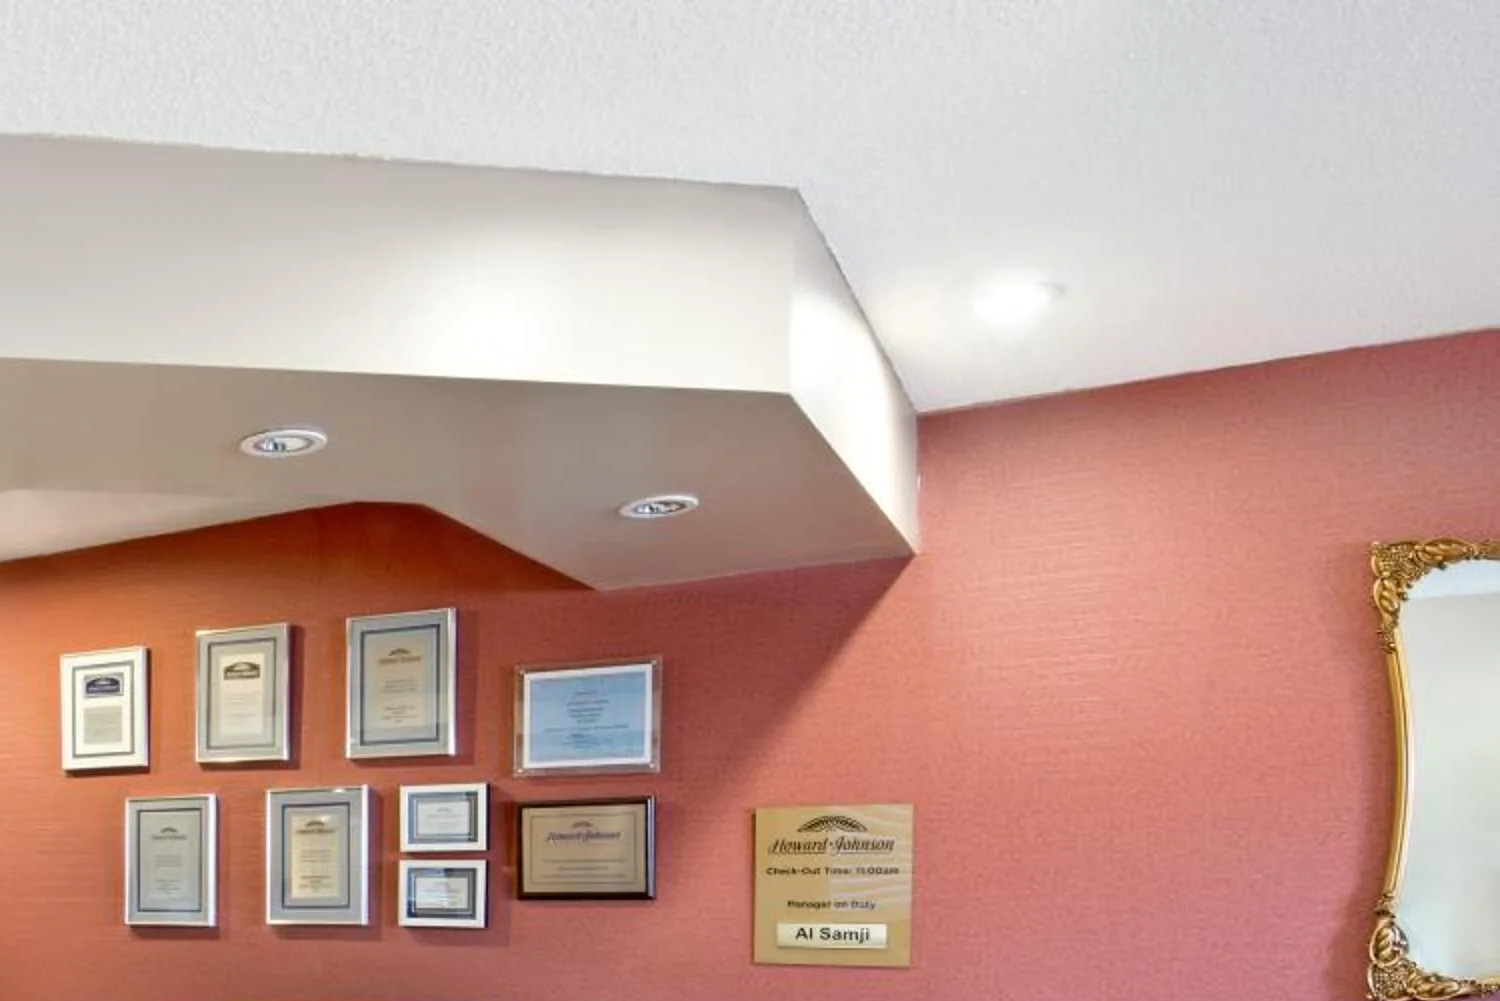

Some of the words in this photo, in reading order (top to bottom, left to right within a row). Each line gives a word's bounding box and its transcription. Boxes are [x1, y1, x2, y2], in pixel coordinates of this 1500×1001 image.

[767, 838, 829, 854] Howard
[834, 836, 895, 855] Johnson
[819, 926, 870, 944] Samji
